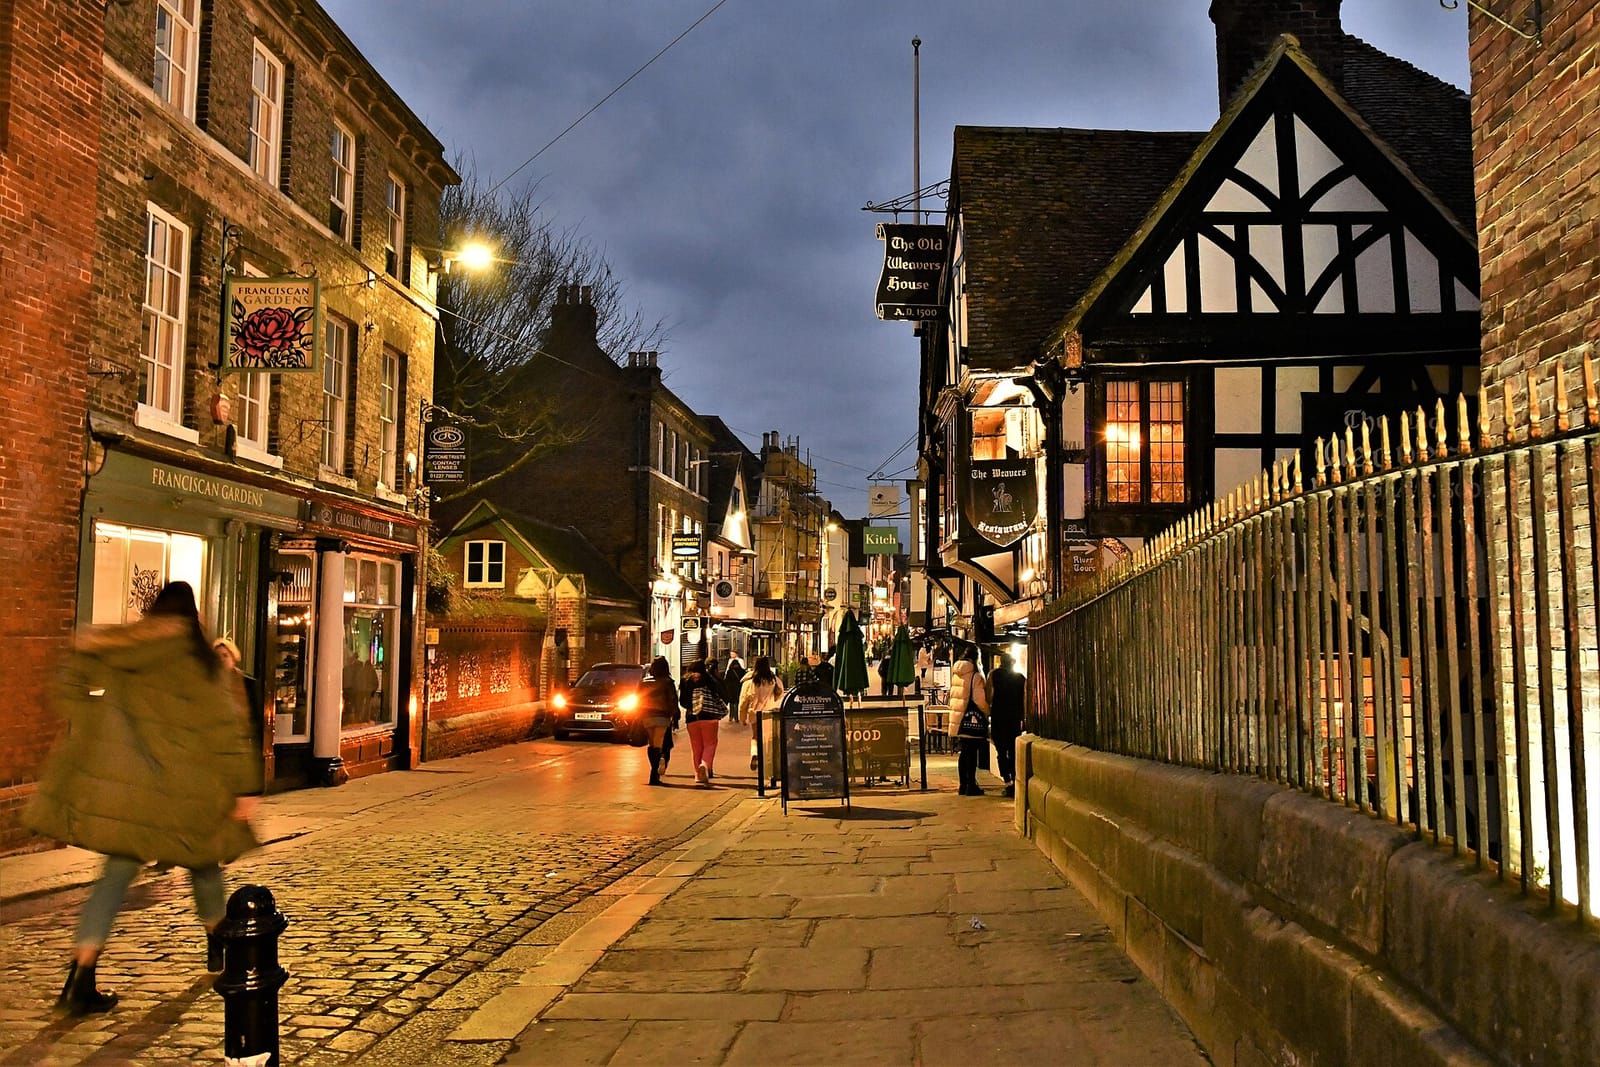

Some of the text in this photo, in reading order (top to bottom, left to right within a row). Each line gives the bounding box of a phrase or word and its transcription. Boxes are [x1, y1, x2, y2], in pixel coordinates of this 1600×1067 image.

[891, 236, 943, 252] The Old
[886, 255, 941, 270] Weavers
[886, 275, 930, 292] House
[238, 287, 310, 296] FRANCISCAN
[243, 294, 310, 305] GARDENS
[971, 468, 1027, 480] The Weavers
[151, 467, 264, 508] FRANCISCAN GARDENS
[977, 520, 1029, 534] Restaurant
[865, 533, 897, 545] Kitch
[1073, 555, 1095, 564] River
[1073, 563, 1097, 572] Tours
